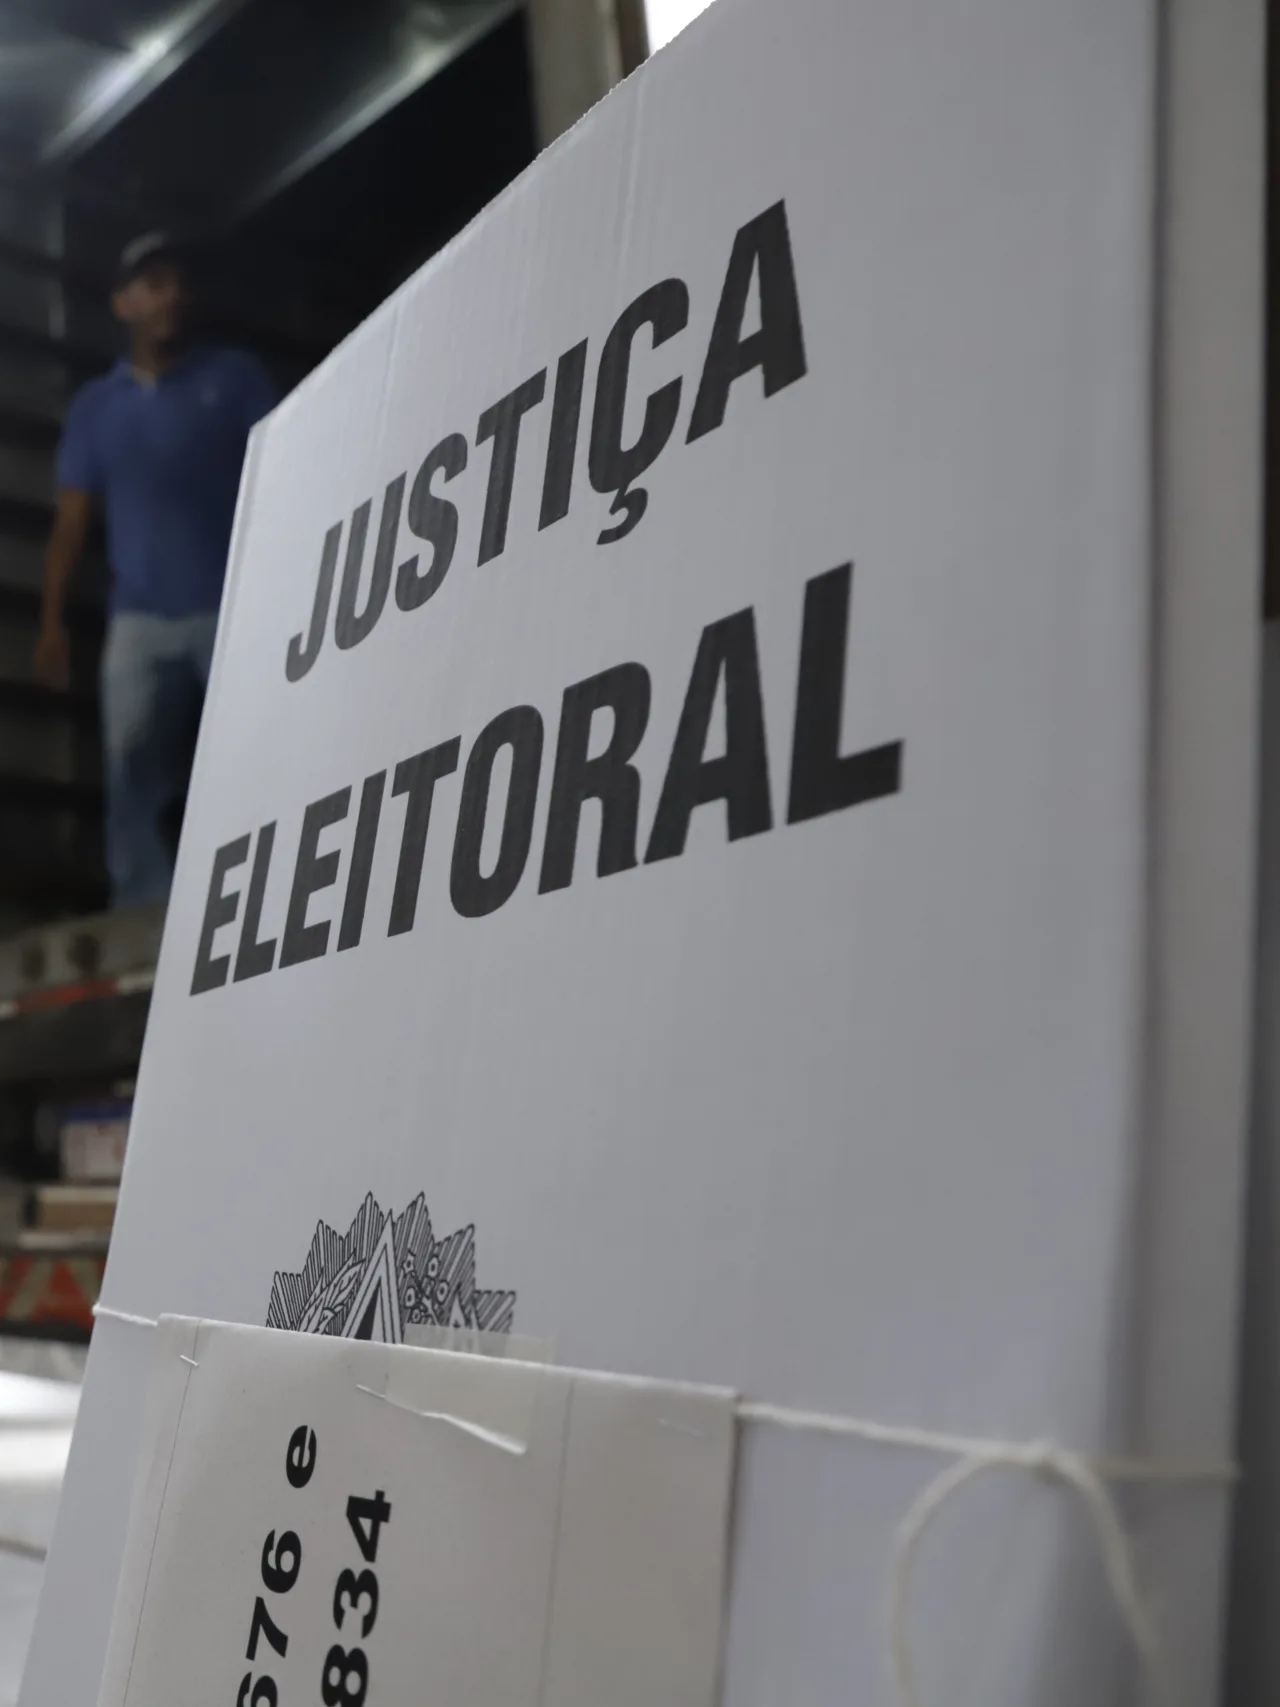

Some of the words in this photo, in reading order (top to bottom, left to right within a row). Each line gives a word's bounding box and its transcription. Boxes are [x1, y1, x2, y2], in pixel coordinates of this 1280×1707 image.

[285, 198, 807, 682] JUSTIÇA
[189, 561, 904, 996] ELEITORAL
[286, 1424, 317, 1489] e
[321, 1490, 392, 1707] 834
